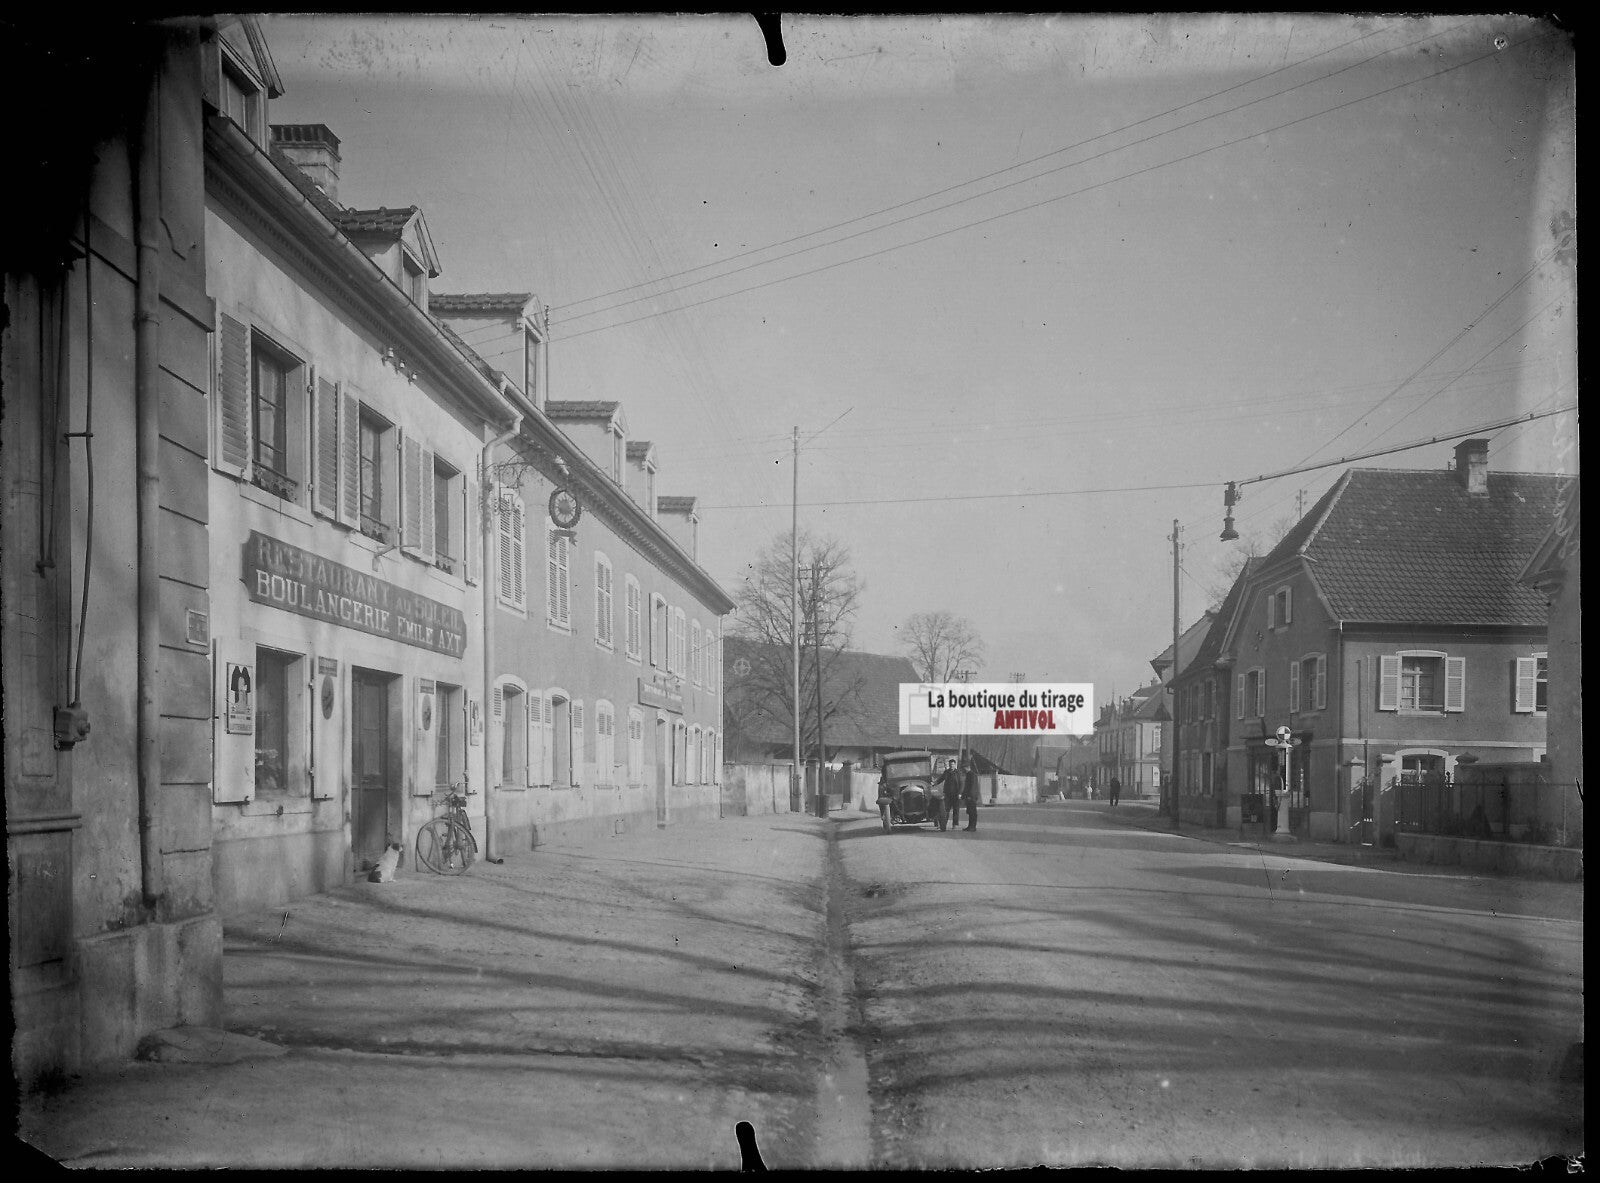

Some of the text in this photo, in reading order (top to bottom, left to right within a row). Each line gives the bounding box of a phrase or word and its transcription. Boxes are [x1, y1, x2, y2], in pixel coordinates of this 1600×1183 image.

[256, 569, 462, 654] BOULANGERIE EMILE AXT
